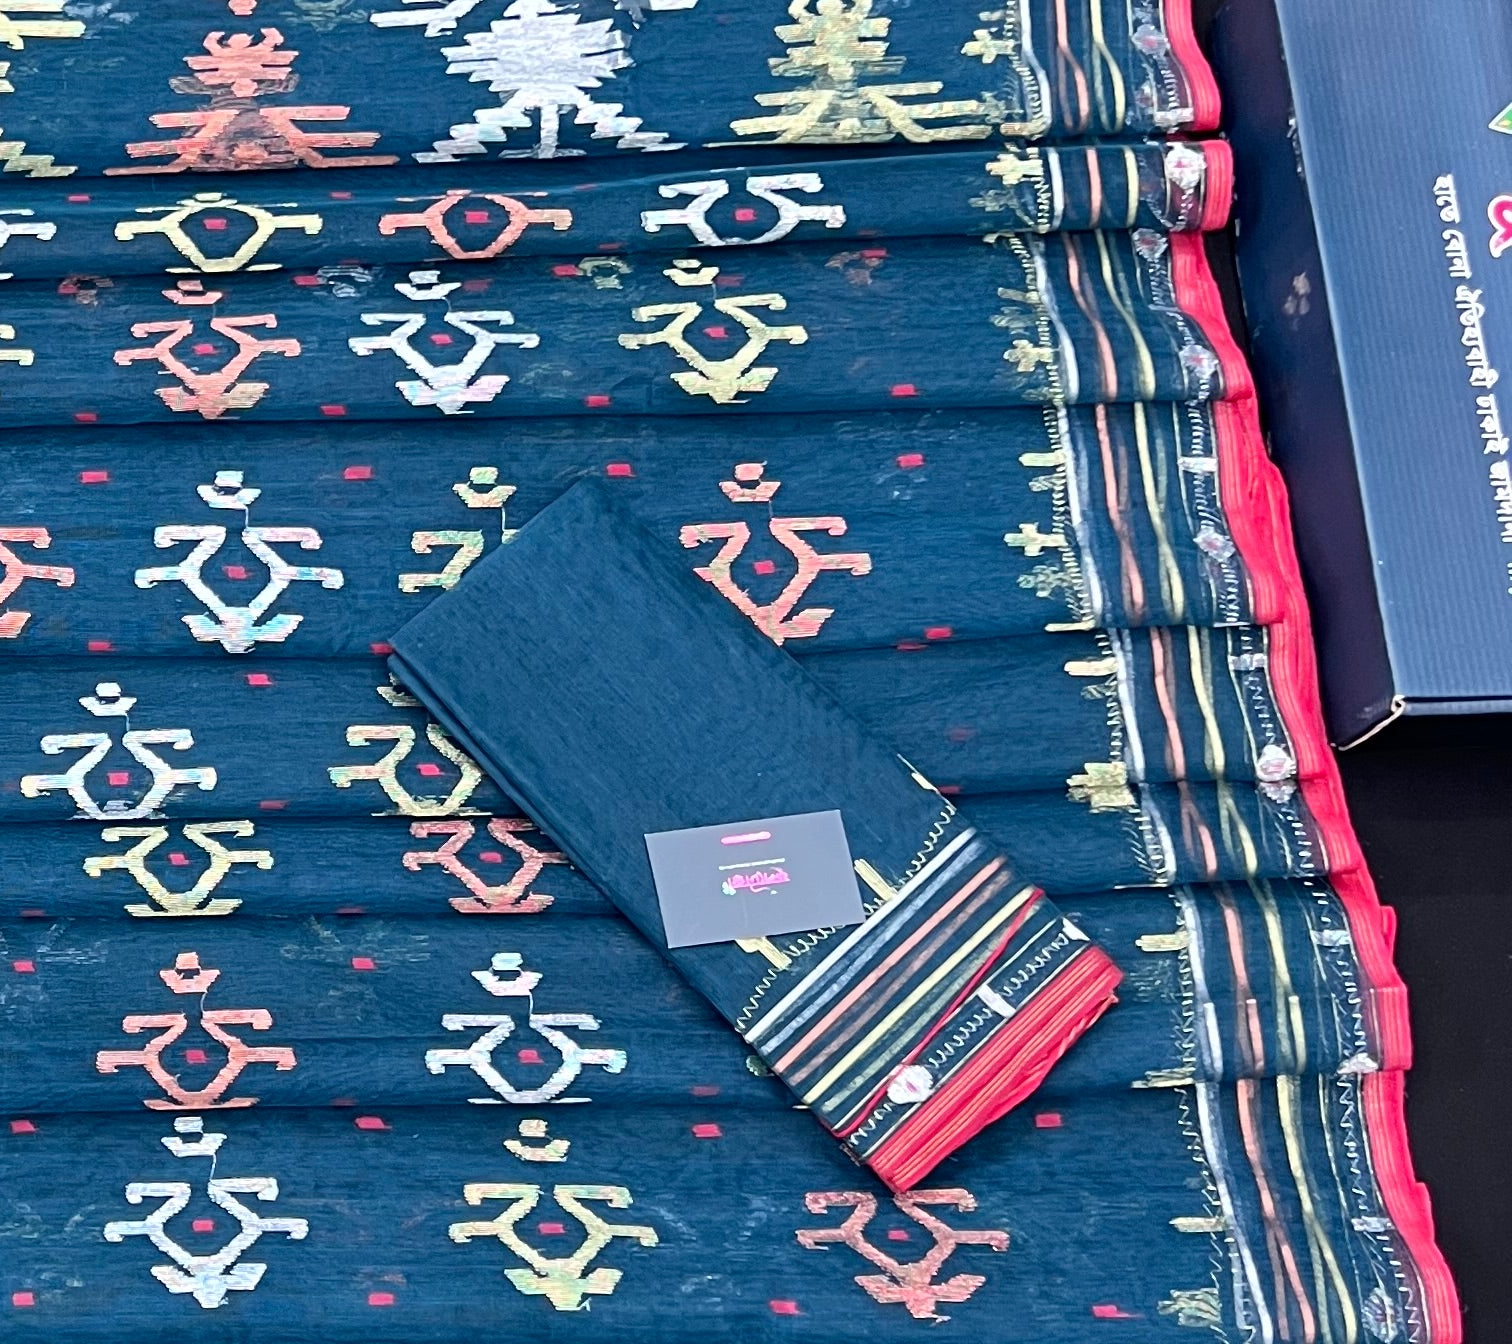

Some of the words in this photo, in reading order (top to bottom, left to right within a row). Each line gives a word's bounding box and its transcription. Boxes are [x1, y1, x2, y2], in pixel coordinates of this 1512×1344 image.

[1433, 173, 1460, 224] হাতে
[1442, 229, 1472, 279] বোনা
[1476, 393, 1509, 454] ঢাকাই
